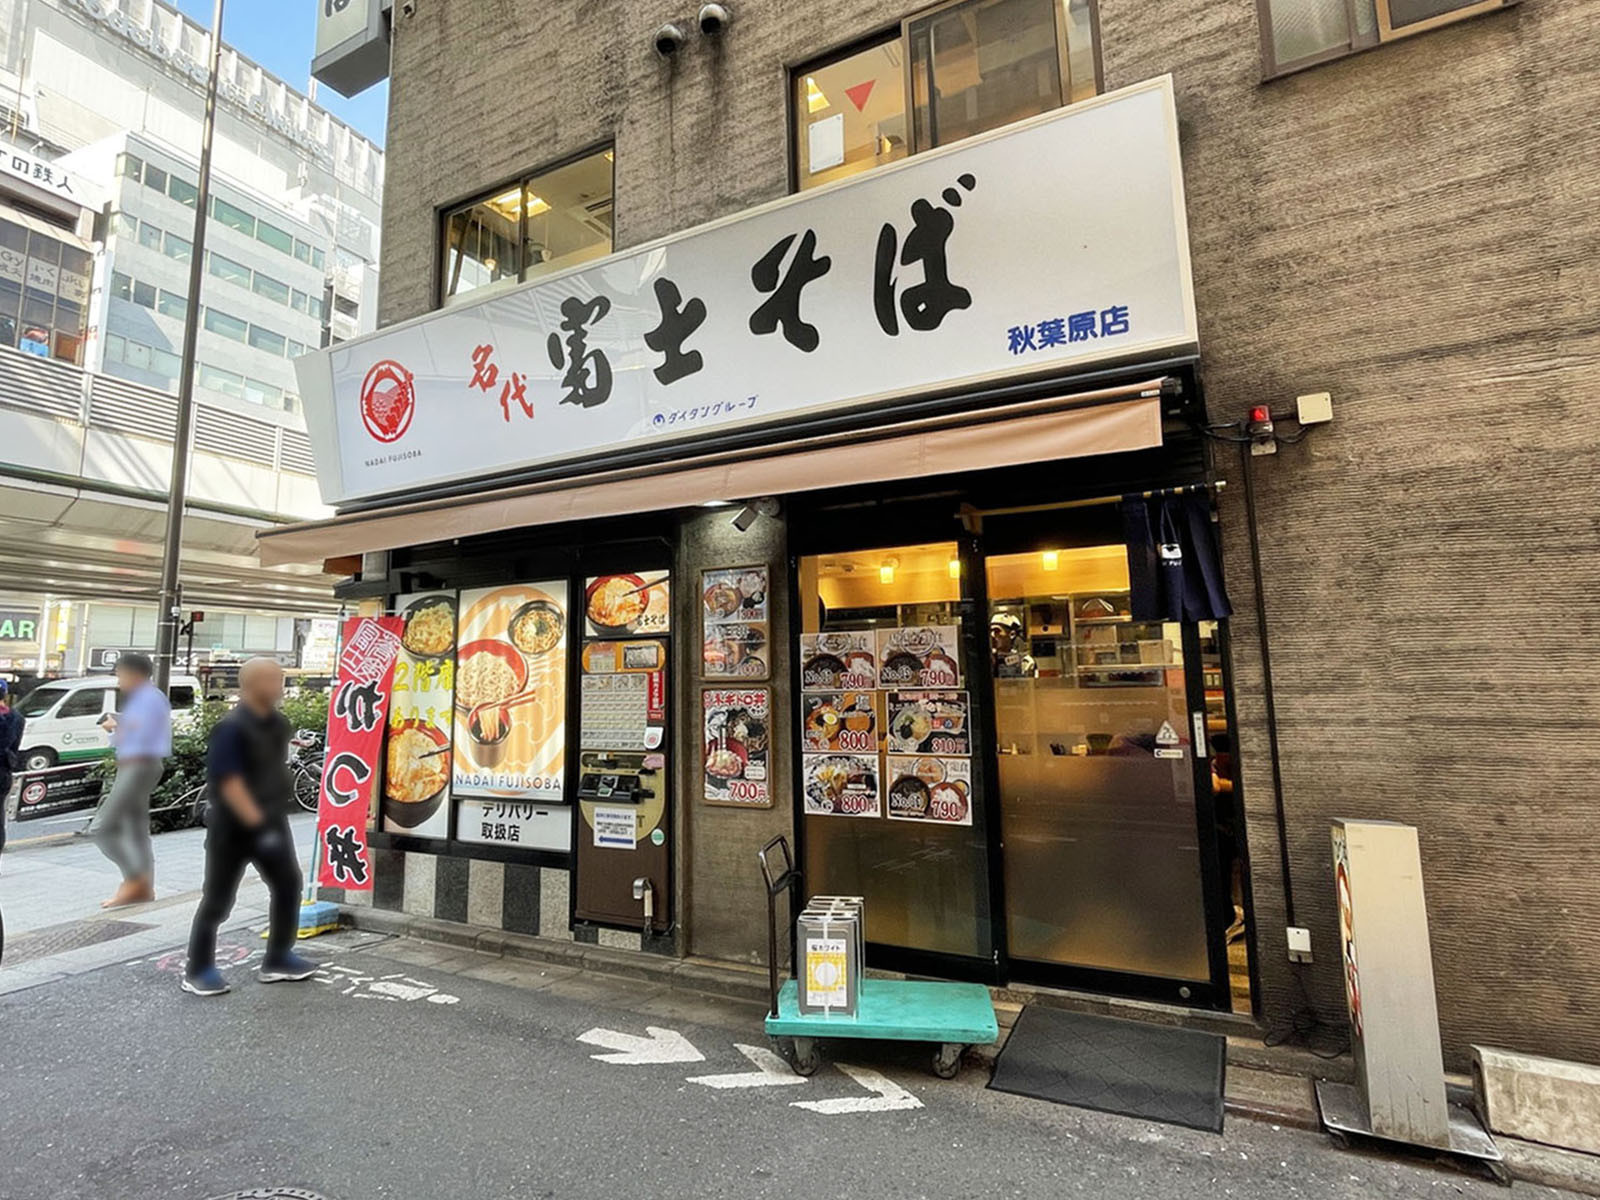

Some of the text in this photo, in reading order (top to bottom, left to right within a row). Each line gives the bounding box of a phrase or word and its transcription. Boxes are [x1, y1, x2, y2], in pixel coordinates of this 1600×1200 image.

[547, 172, 977, 408] 富士そば
[1007, 304, 1131, 356] 秋葉原店
[668, 394, 760, 425] ダイタングループ
[364, 449, 422, 468] NADAI FUJISOBA
[323, 679, 386, 885] かつ丼
[455, 774, 562, 791] NADAI FUJISOBA
[481, 803, 549, 821] デリバリー
[481, 822, 521, 842] 取扱店
